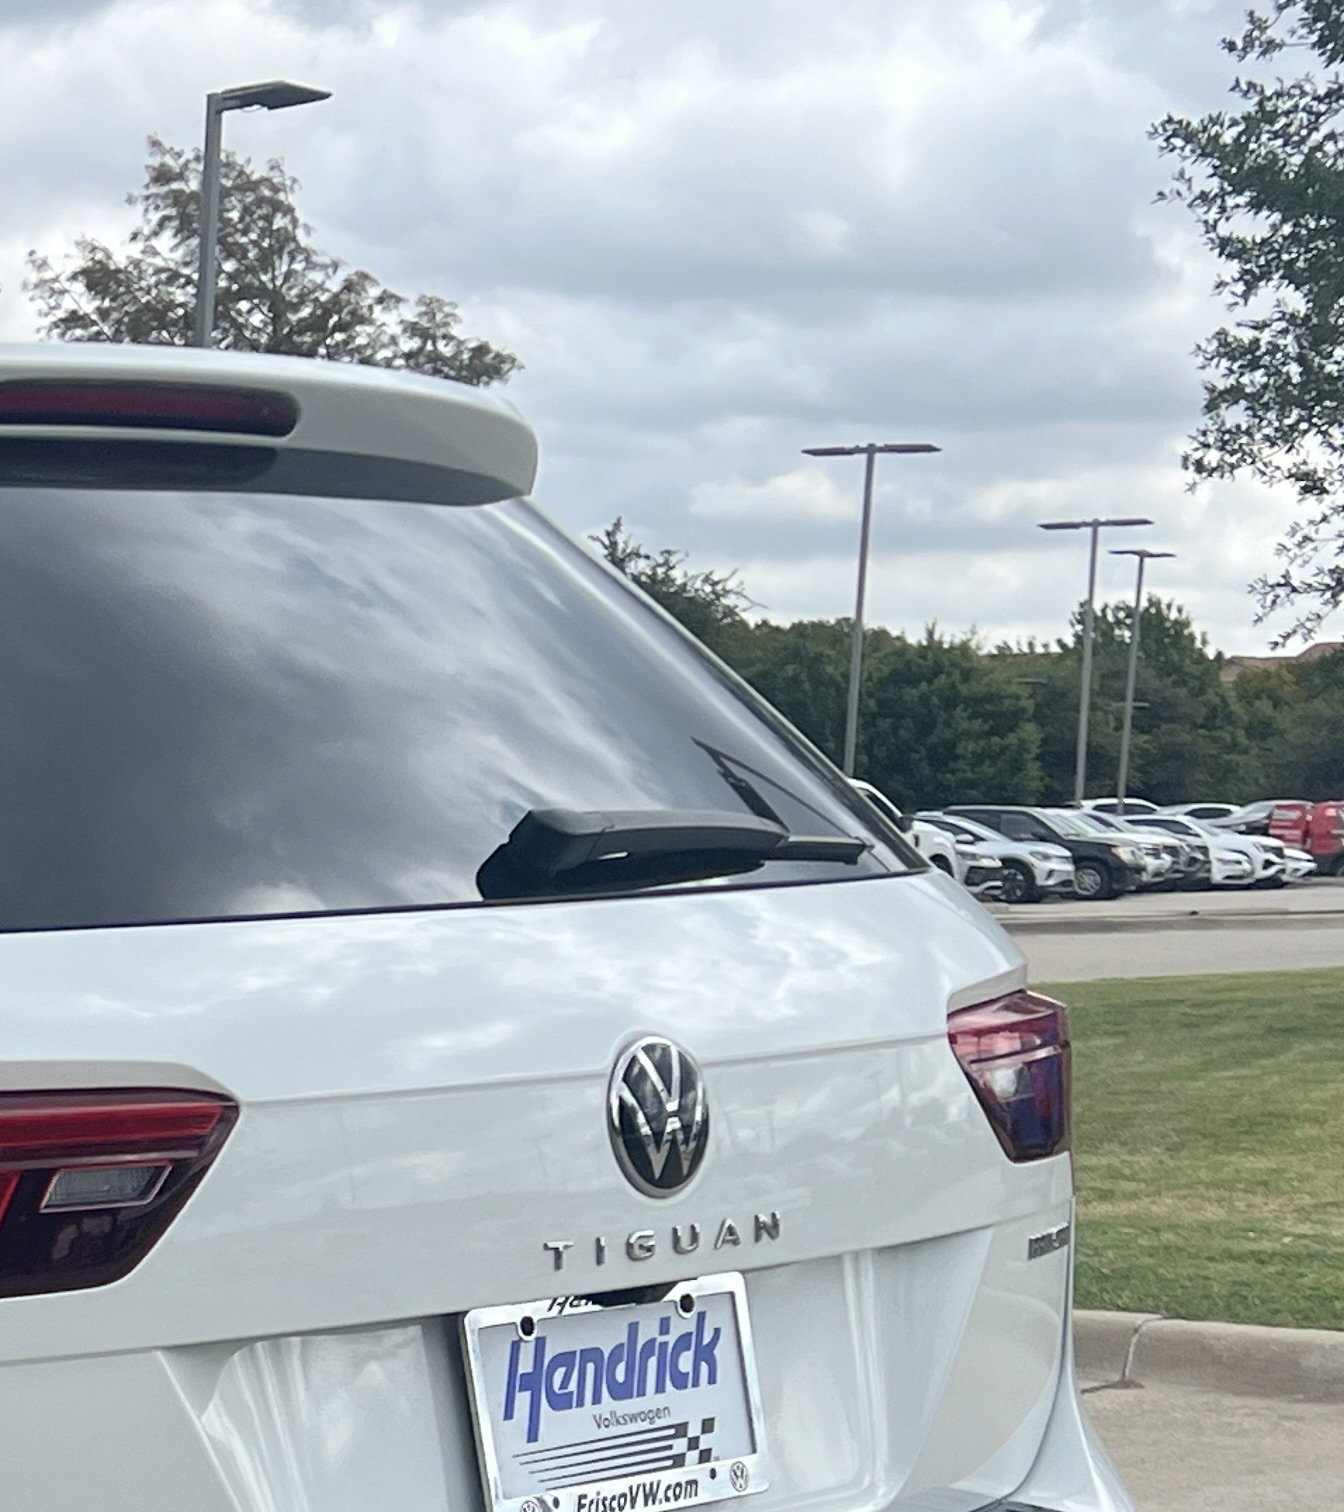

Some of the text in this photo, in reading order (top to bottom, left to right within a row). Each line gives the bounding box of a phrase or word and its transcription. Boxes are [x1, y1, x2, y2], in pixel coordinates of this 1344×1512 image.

[543, 1210, 782, 1272] TIGUAN
[502, 1310, 722, 1443] Hendrick
[592, 1405, 672, 1430] Volkswagen
